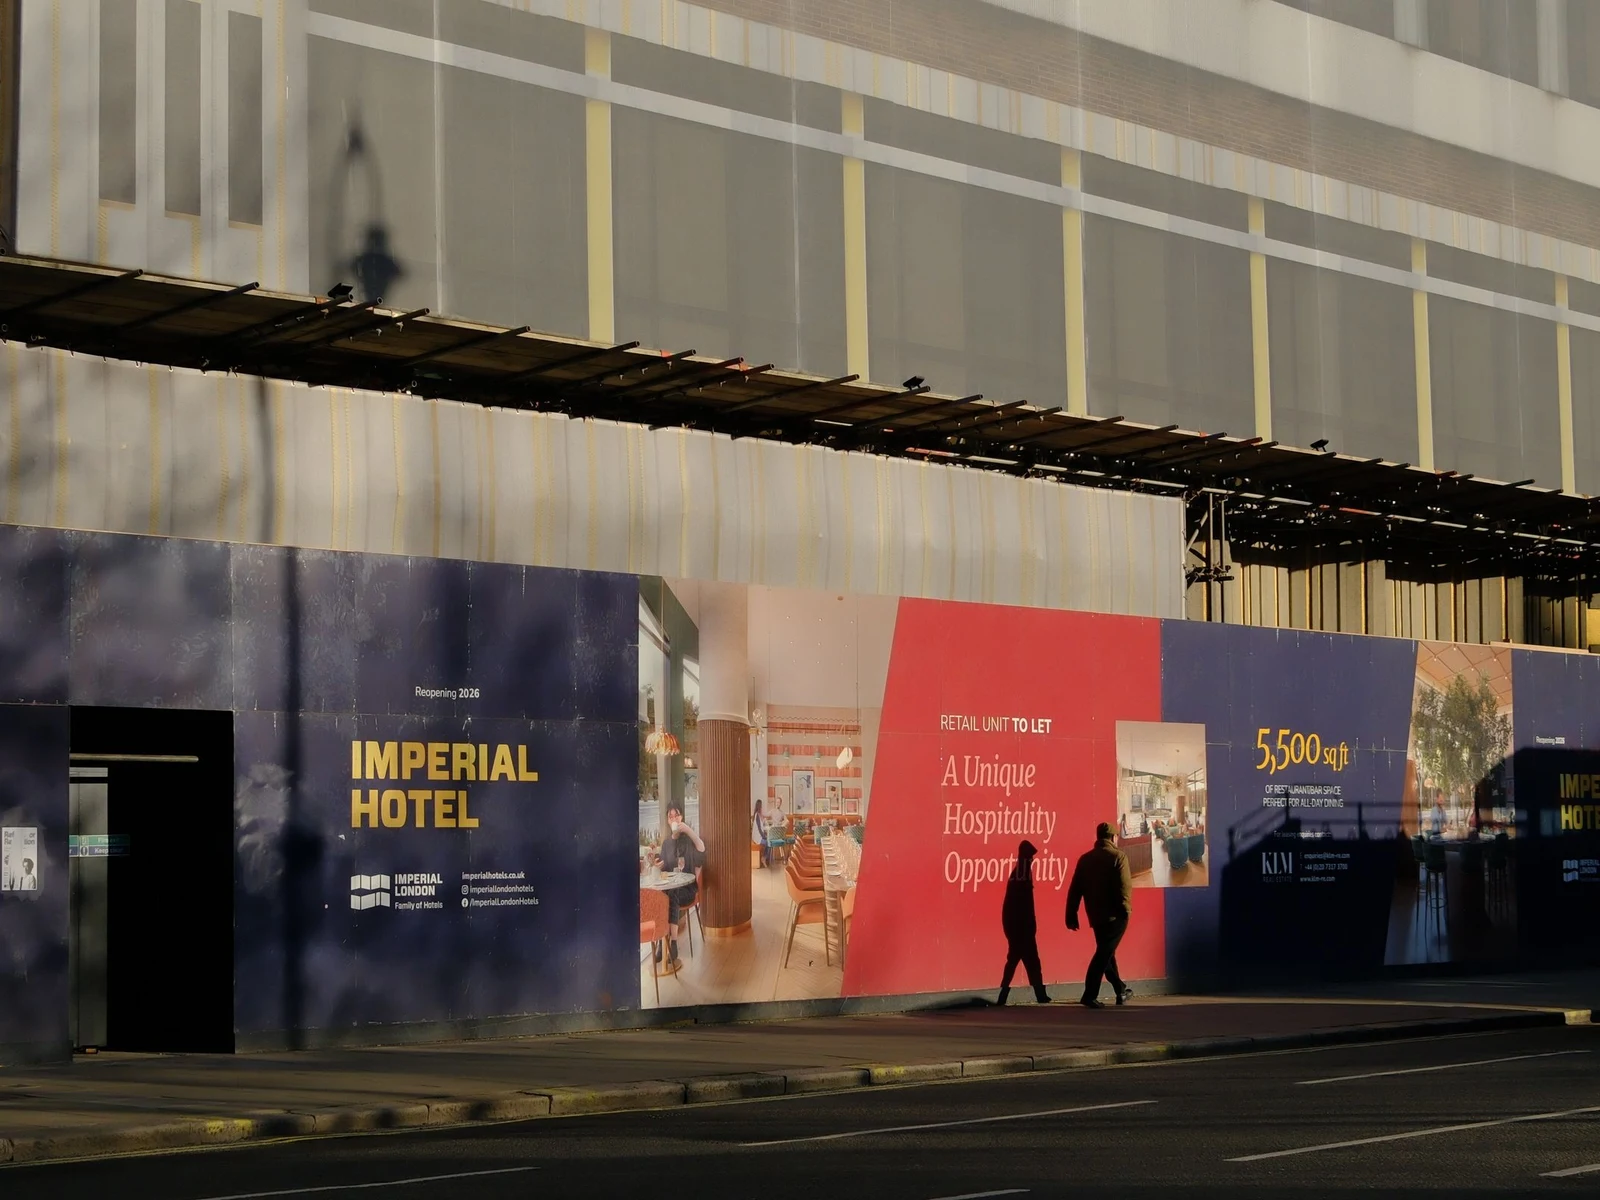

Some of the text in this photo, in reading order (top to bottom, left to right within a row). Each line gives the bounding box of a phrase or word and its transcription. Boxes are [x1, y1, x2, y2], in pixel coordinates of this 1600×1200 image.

[415, 686, 480, 700] Reopening 2026
[940, 714, 1052, 734] RETAIL UNIT TO LET
[1256, 728, 1321, 775] 5,500
[351, 740, 539, 782] IMPERIAL
[941, 753, 1036, 797] A Unique
[1265, 784, 1274, 794] OF
[1323, 785, 1342, 796] SPACE
[351, 789, 480, 829] HOTEL
[1262, 797, 1344, 808] PERFECT FOR ALL-DAY DINING
[943, 801, 1057, 845] Hospitality
[394, 873, 443, 885] IMPERIAL
[461, 871, 526, 881] imperialhotels.co.uk
[394, 885, 436, 897] LONDON
[470, 884, 534, 894] imperiallondonhotels
[394, 900, 444, 911] Family of Hotels
